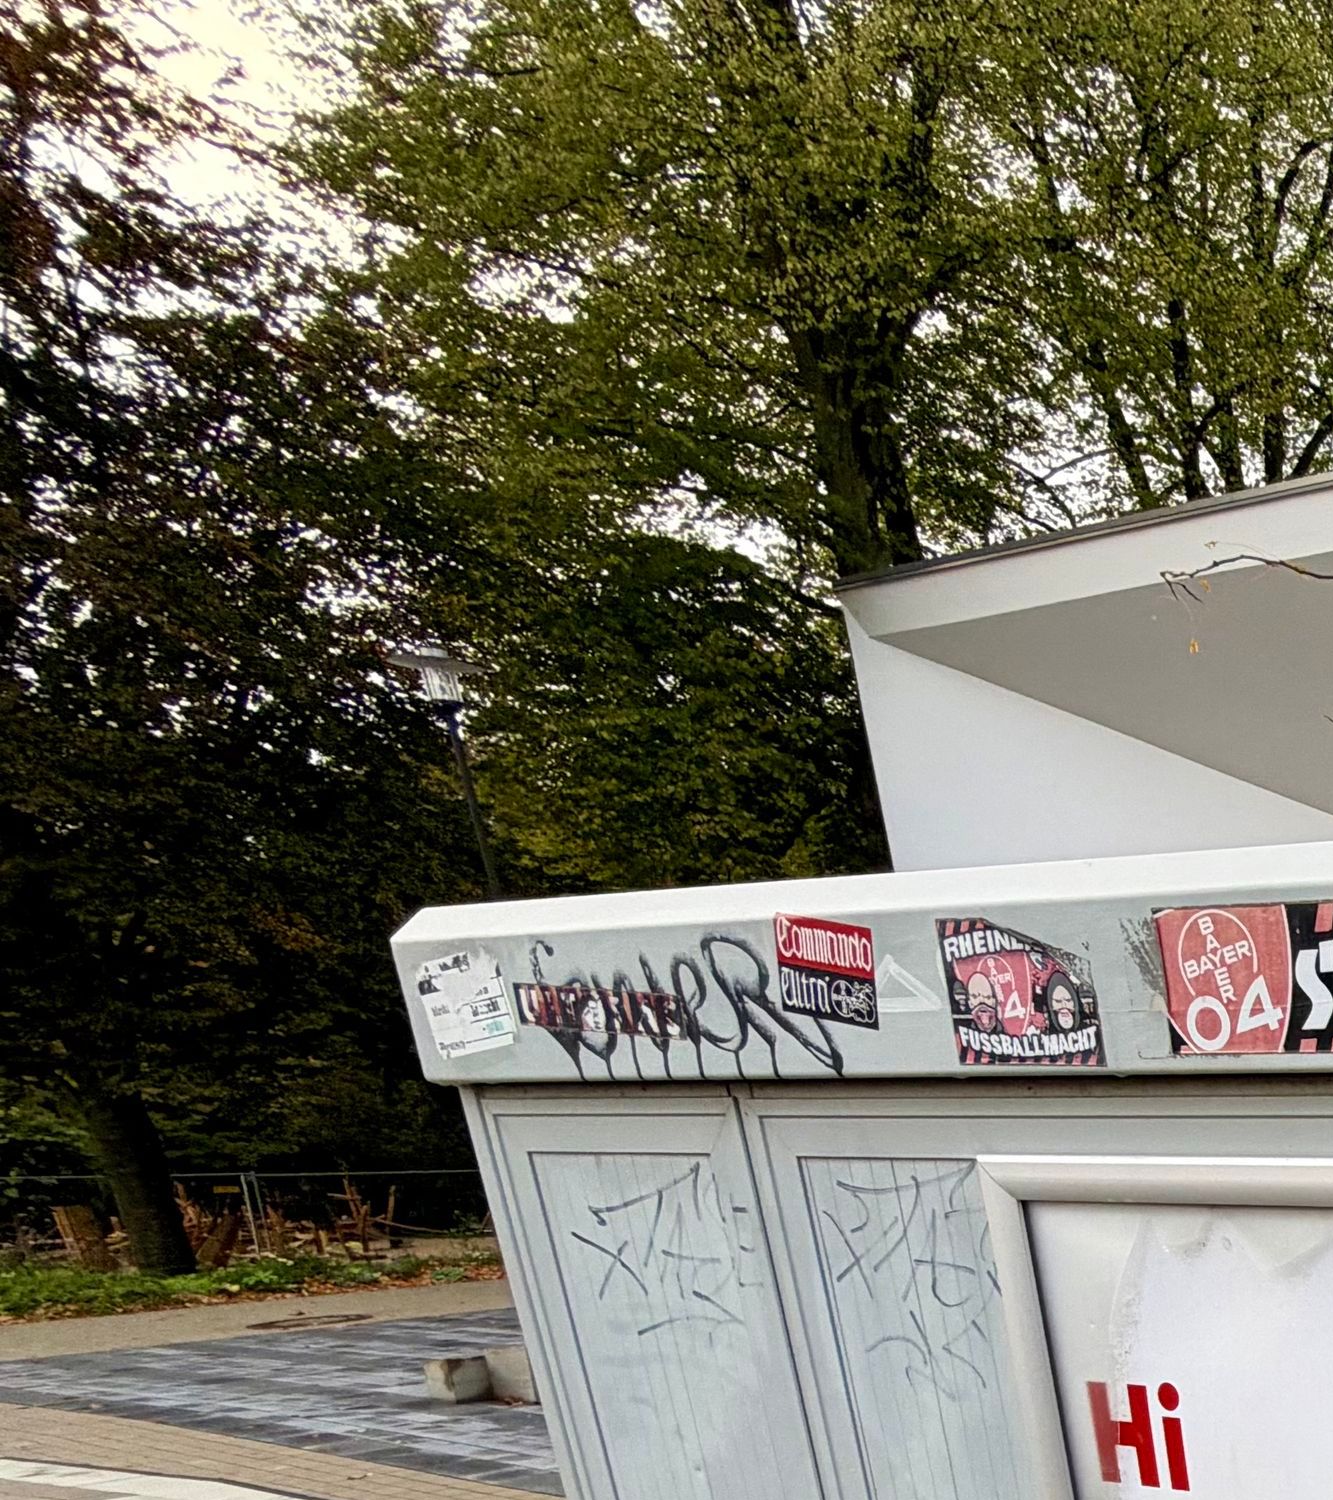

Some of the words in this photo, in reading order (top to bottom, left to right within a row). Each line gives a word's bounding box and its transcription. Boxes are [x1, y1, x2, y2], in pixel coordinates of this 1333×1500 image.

[776, 915, 872, 972] Commando
[1183, 940, 1252, 979] BAYER
[1197, 916, 1237, 1004] BAYER
[1186, 974, 1285, 1051] 04
[1086, 1381, 1191, 1492] Hi
